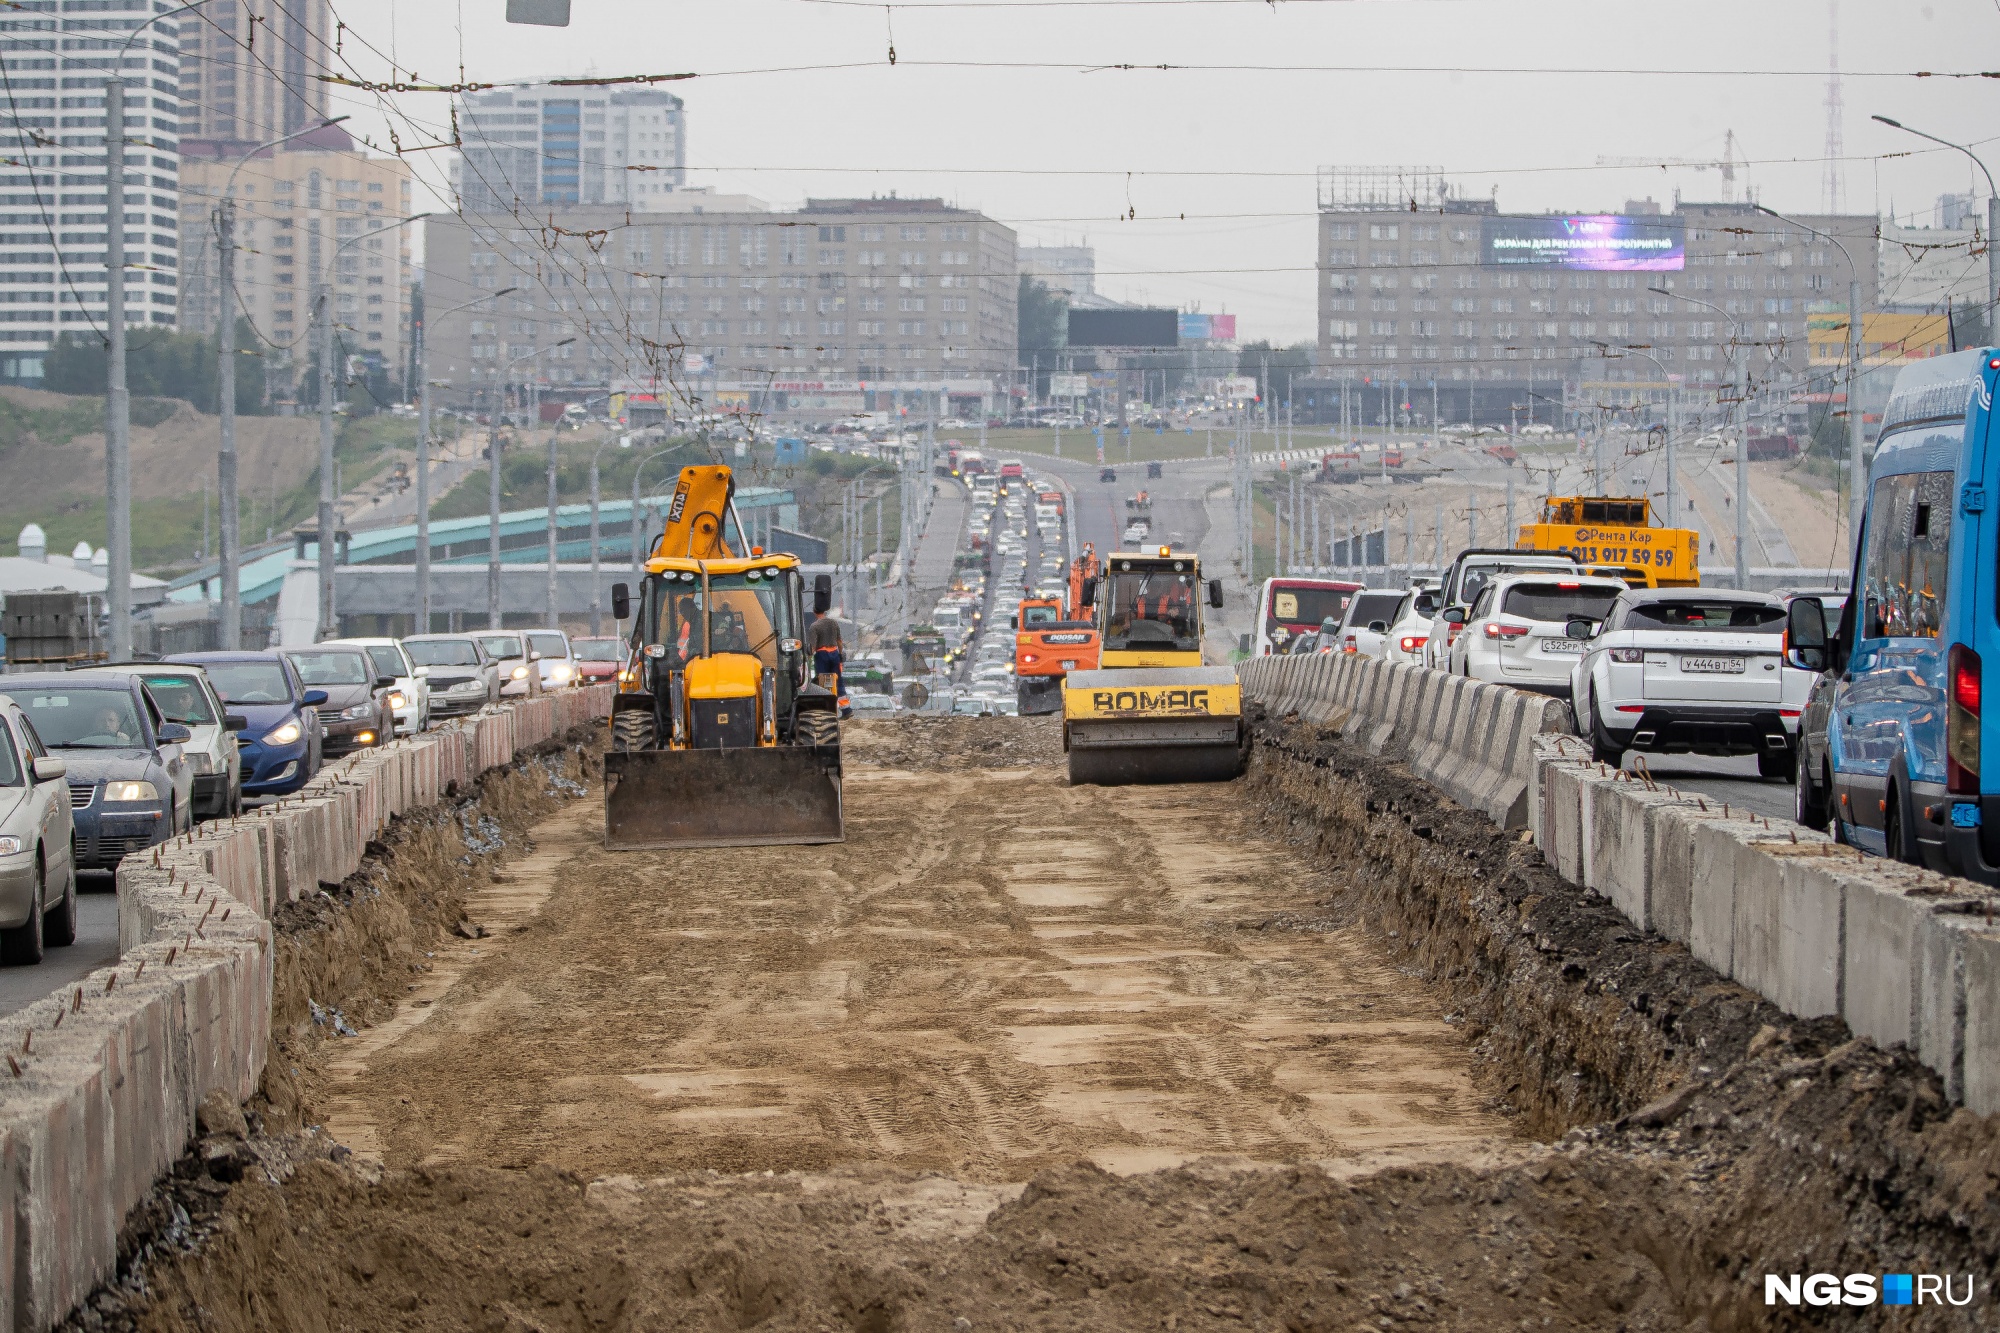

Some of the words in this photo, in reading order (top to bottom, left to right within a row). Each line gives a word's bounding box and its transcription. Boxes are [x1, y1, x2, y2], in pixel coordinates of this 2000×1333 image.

[1493, 238, 1531, 249] ЭКРАНЫ
[1532, 238, 1551, 250] ДЛЯ
[1552, 238, 1596, 249] РЕКЛАМЫ
[1597, 238, 1604, 249] И
[1605, 238, 1673, 249] МЕРОПРИЯТИЙ
[669, 493, 686, 521] 4CX
[1591, 528, 1625, 541] Рента
[1629, 530, 1652, 545] Кар
[1602, 547, 1628, 563] 917
[1632, 548, 1651, 565] 59
[1655, 549, 1674, 567] 59
[1093, 689, 1209, 711] BOMAG
